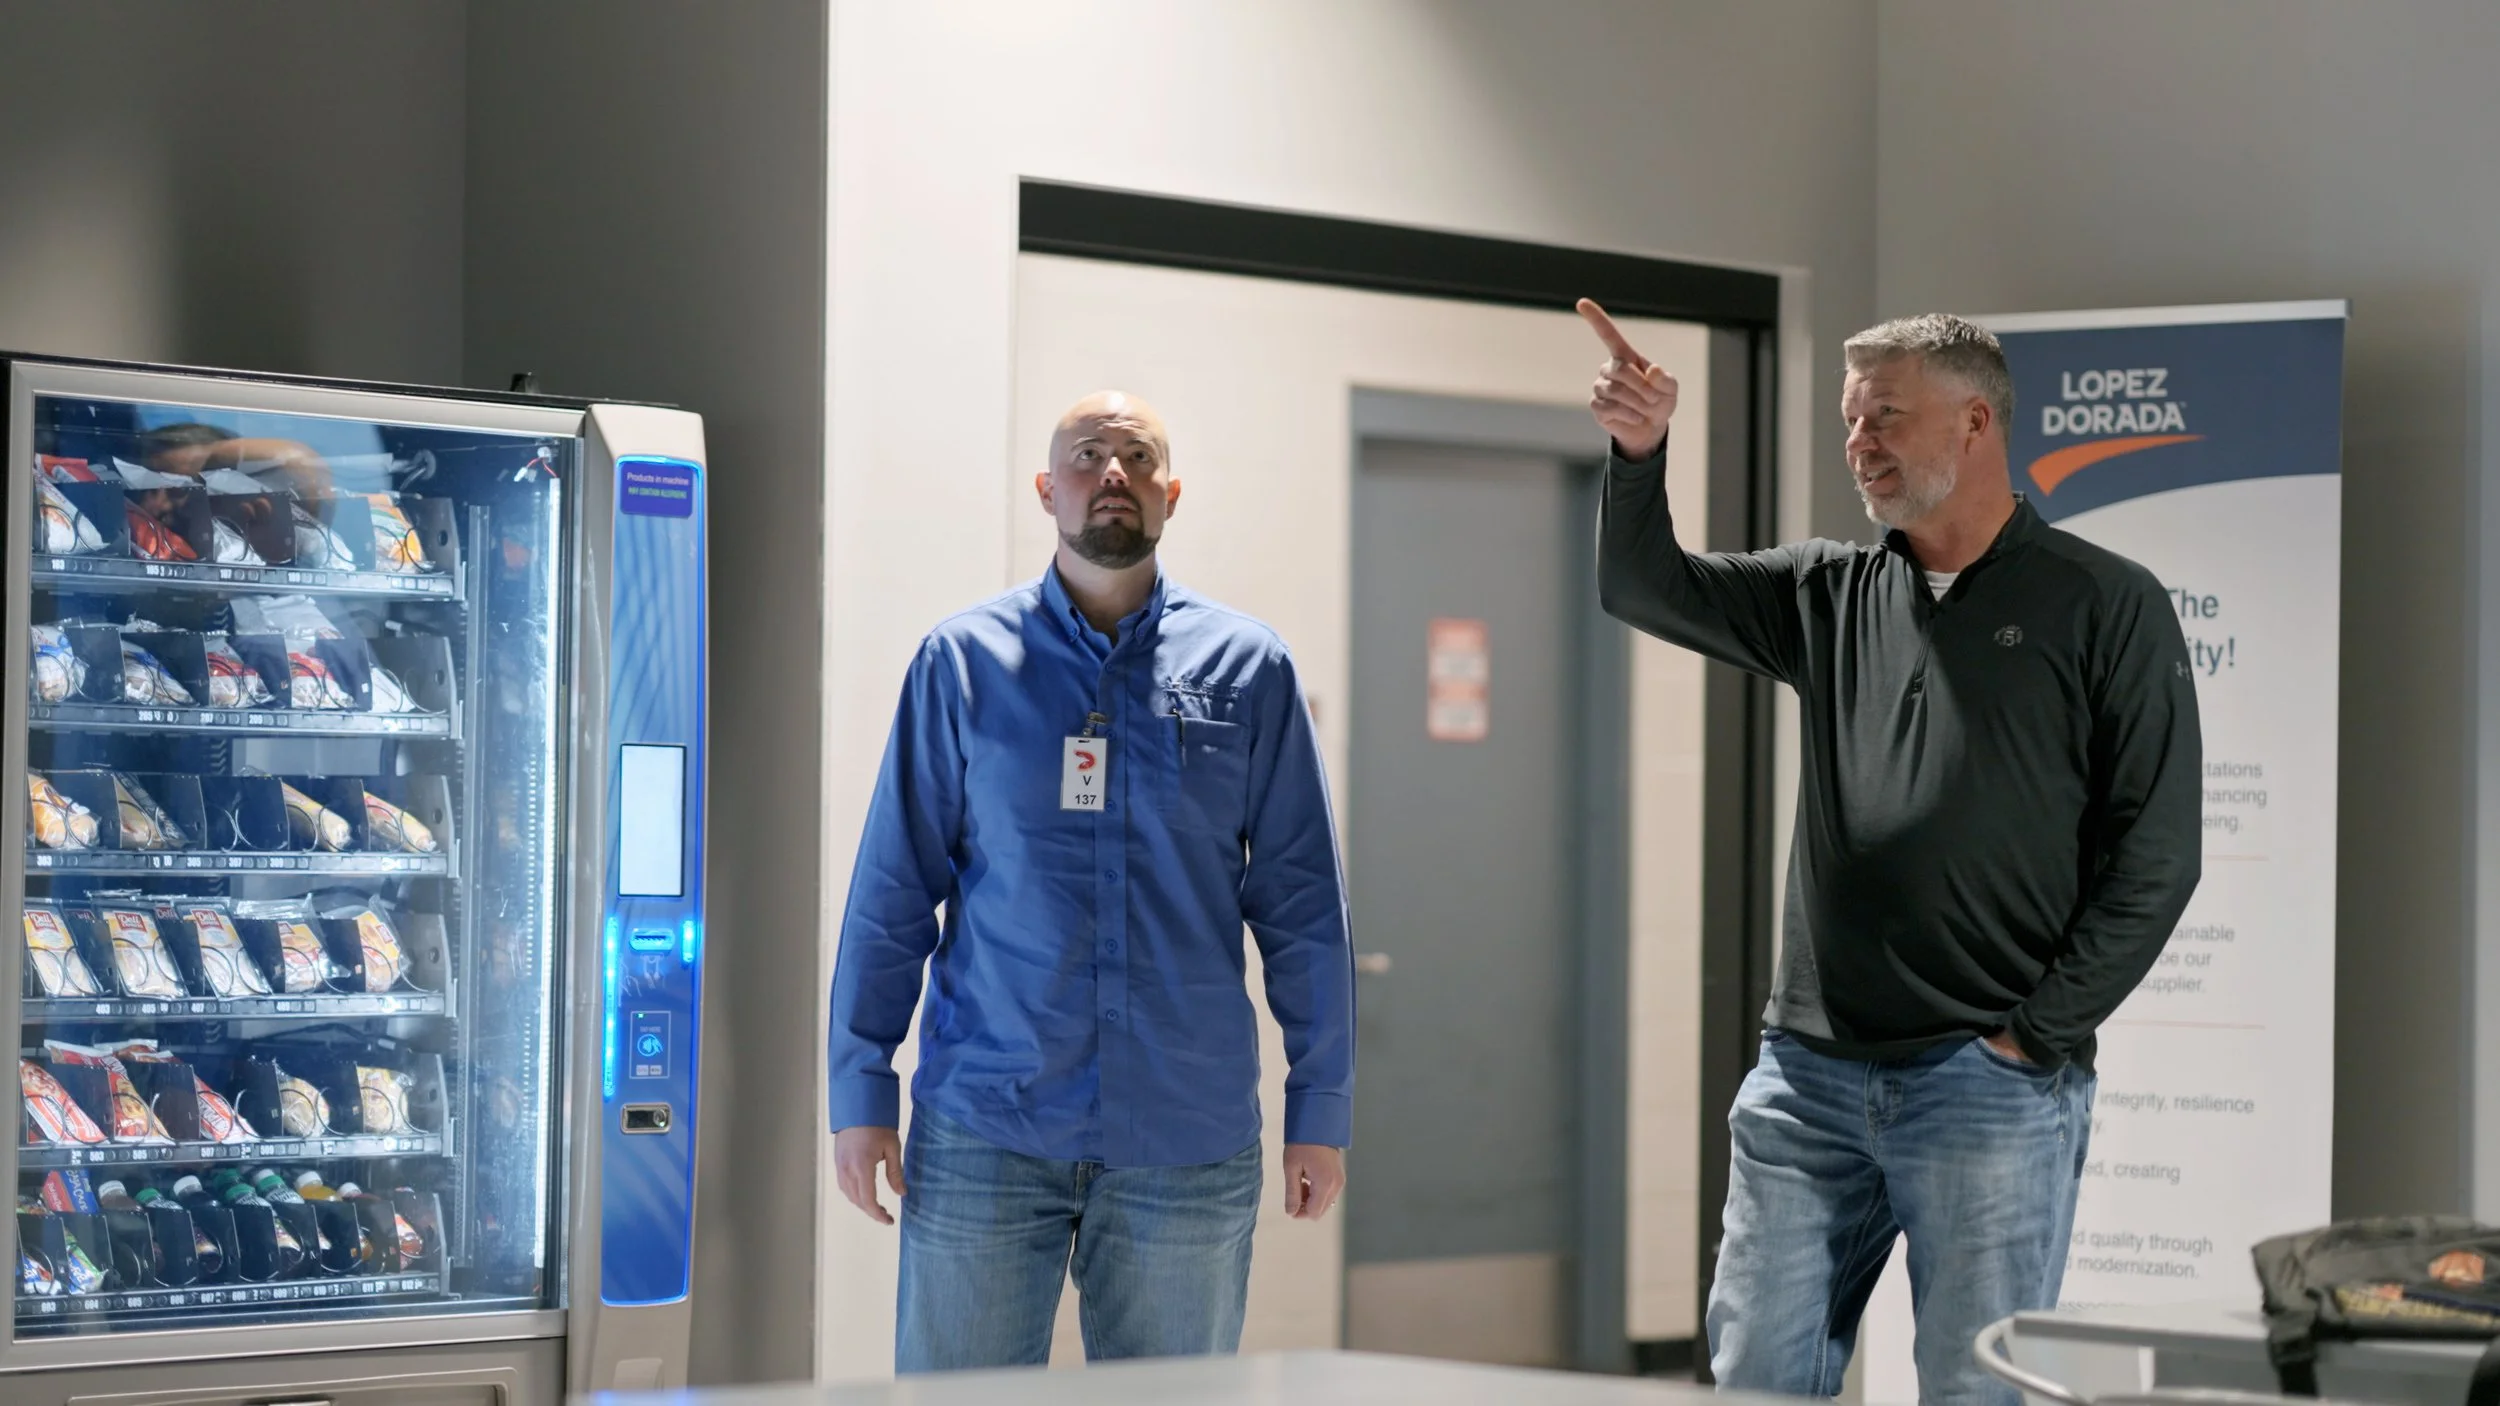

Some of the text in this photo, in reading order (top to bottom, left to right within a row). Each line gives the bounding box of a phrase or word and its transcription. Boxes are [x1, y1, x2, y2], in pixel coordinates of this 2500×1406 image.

[2061, 368, 2168, 401] LOPEZ
[2042, 402, 2186, 436] DORADA
[626, 472, 689, 485] Products in machine
[2186, 636, 2235, 677] ity!
[1082, 775, 1092, 786] V
[1074, 794, 1097, 806] 137
[2203, 812, 2244, 836] eing.
[2184, 950, 2213, 969] our
[2101, 1090, 2257, 1114] integrity, resilience
[2083, 1160, 2182, 1186] ed, creating
[2090, 1230, 2145, 1255] quality
[2149, 1233, 2214, 1258] through
[2077, 1256, 2201, 1280] modernization.
